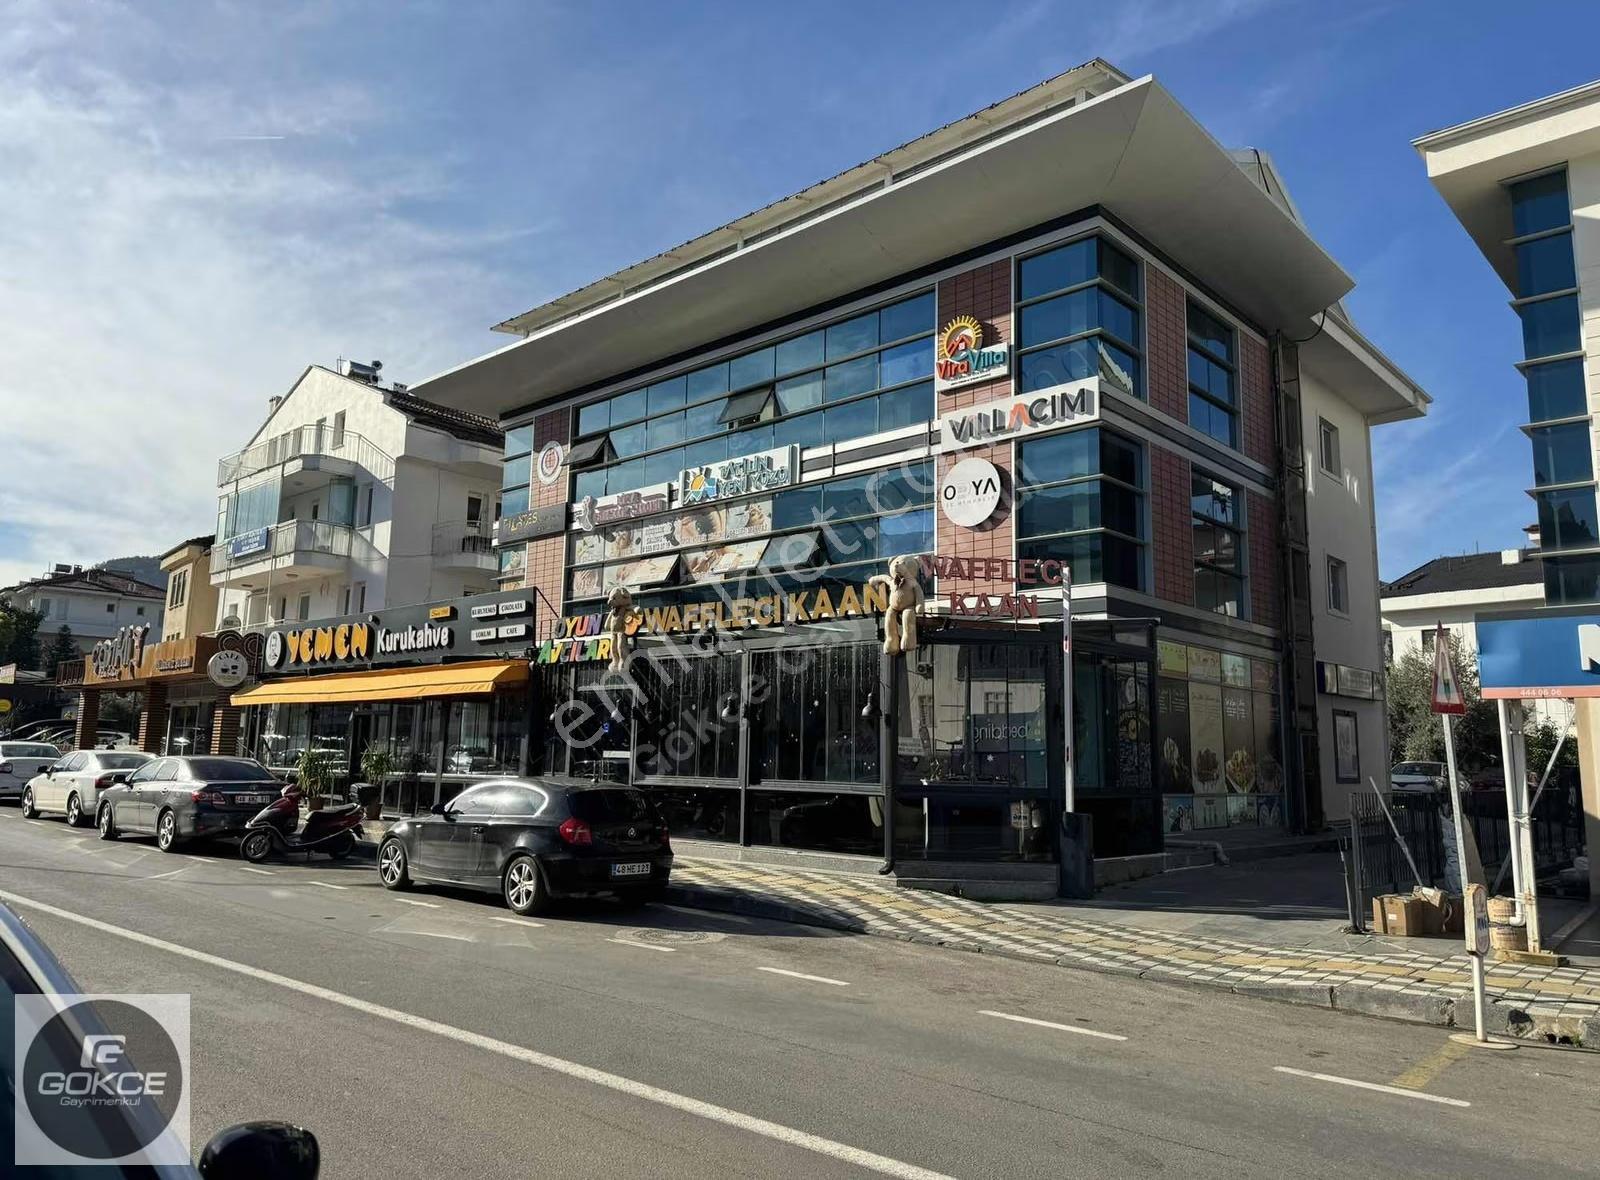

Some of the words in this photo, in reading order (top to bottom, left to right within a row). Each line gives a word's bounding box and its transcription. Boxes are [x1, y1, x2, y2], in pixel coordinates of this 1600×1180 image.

[936, 360, 969, 380] Vira
[968, 349, 1006, 372] Villa
[949, 388, 1089, 442] VILLACIM
[788, 582, 887, 622] KAAN
[950, 592, 1038, 618] KAAN
[286, 622, 369, 663] YEMEN
[377, 622, 449, 653] Kurukahve
